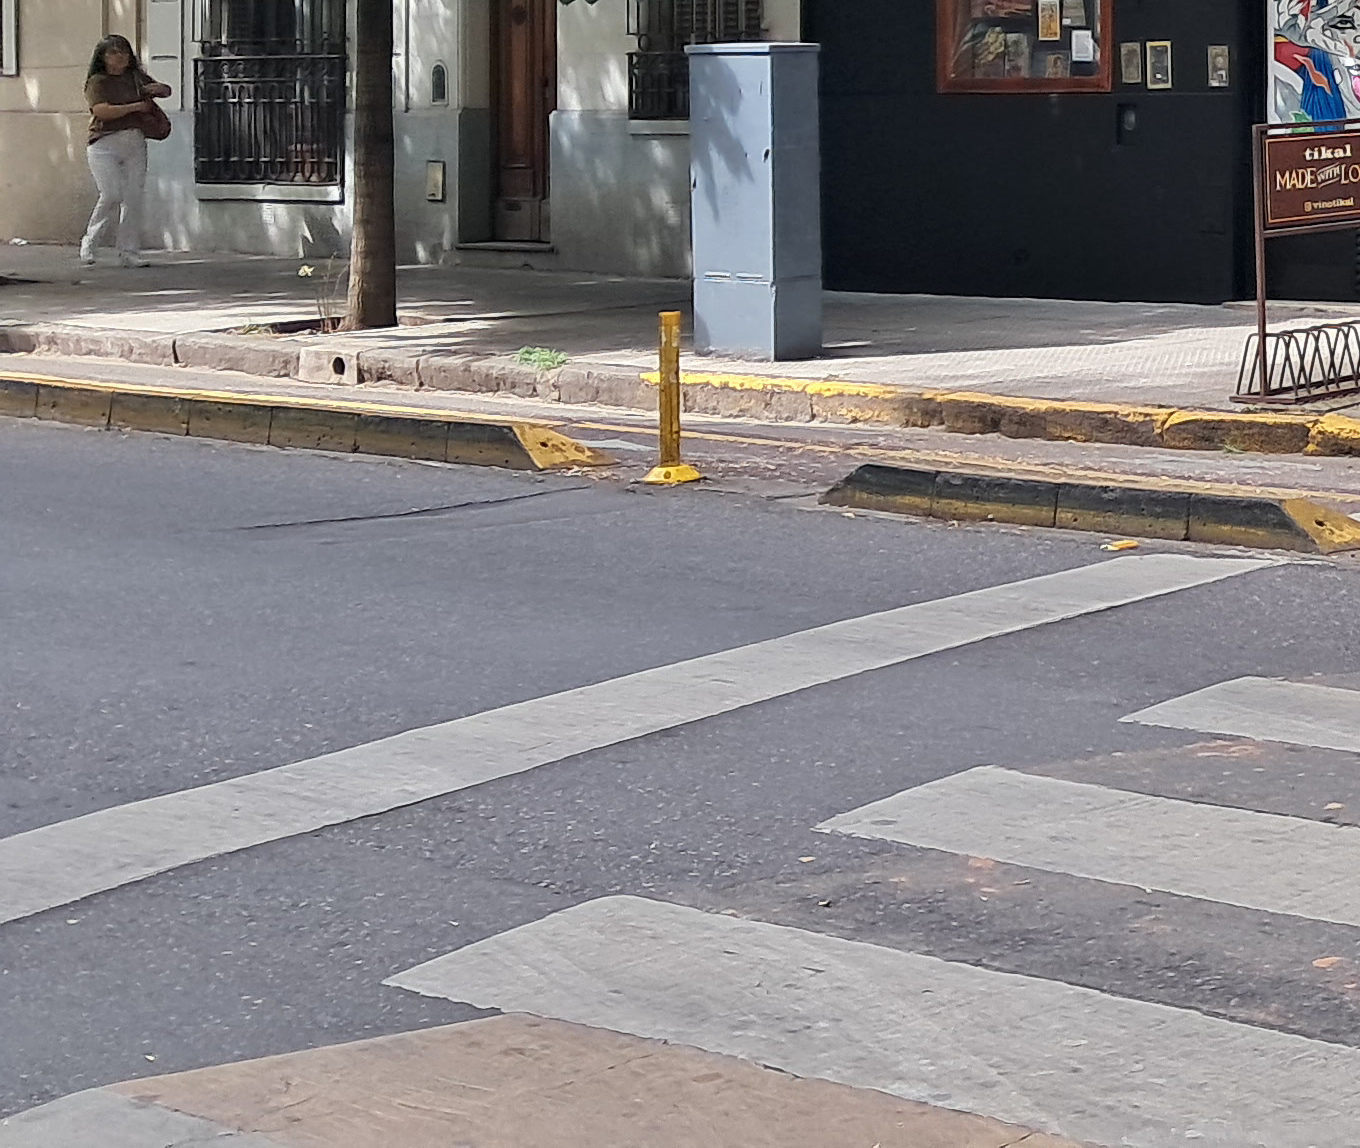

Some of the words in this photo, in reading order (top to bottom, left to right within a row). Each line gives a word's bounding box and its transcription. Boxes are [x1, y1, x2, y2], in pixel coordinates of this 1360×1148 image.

[1304, 143, 1352, 161] tikal
[1275, 167, 1318, 191] MADE
[1316, 166, 1341, 183] WITH
